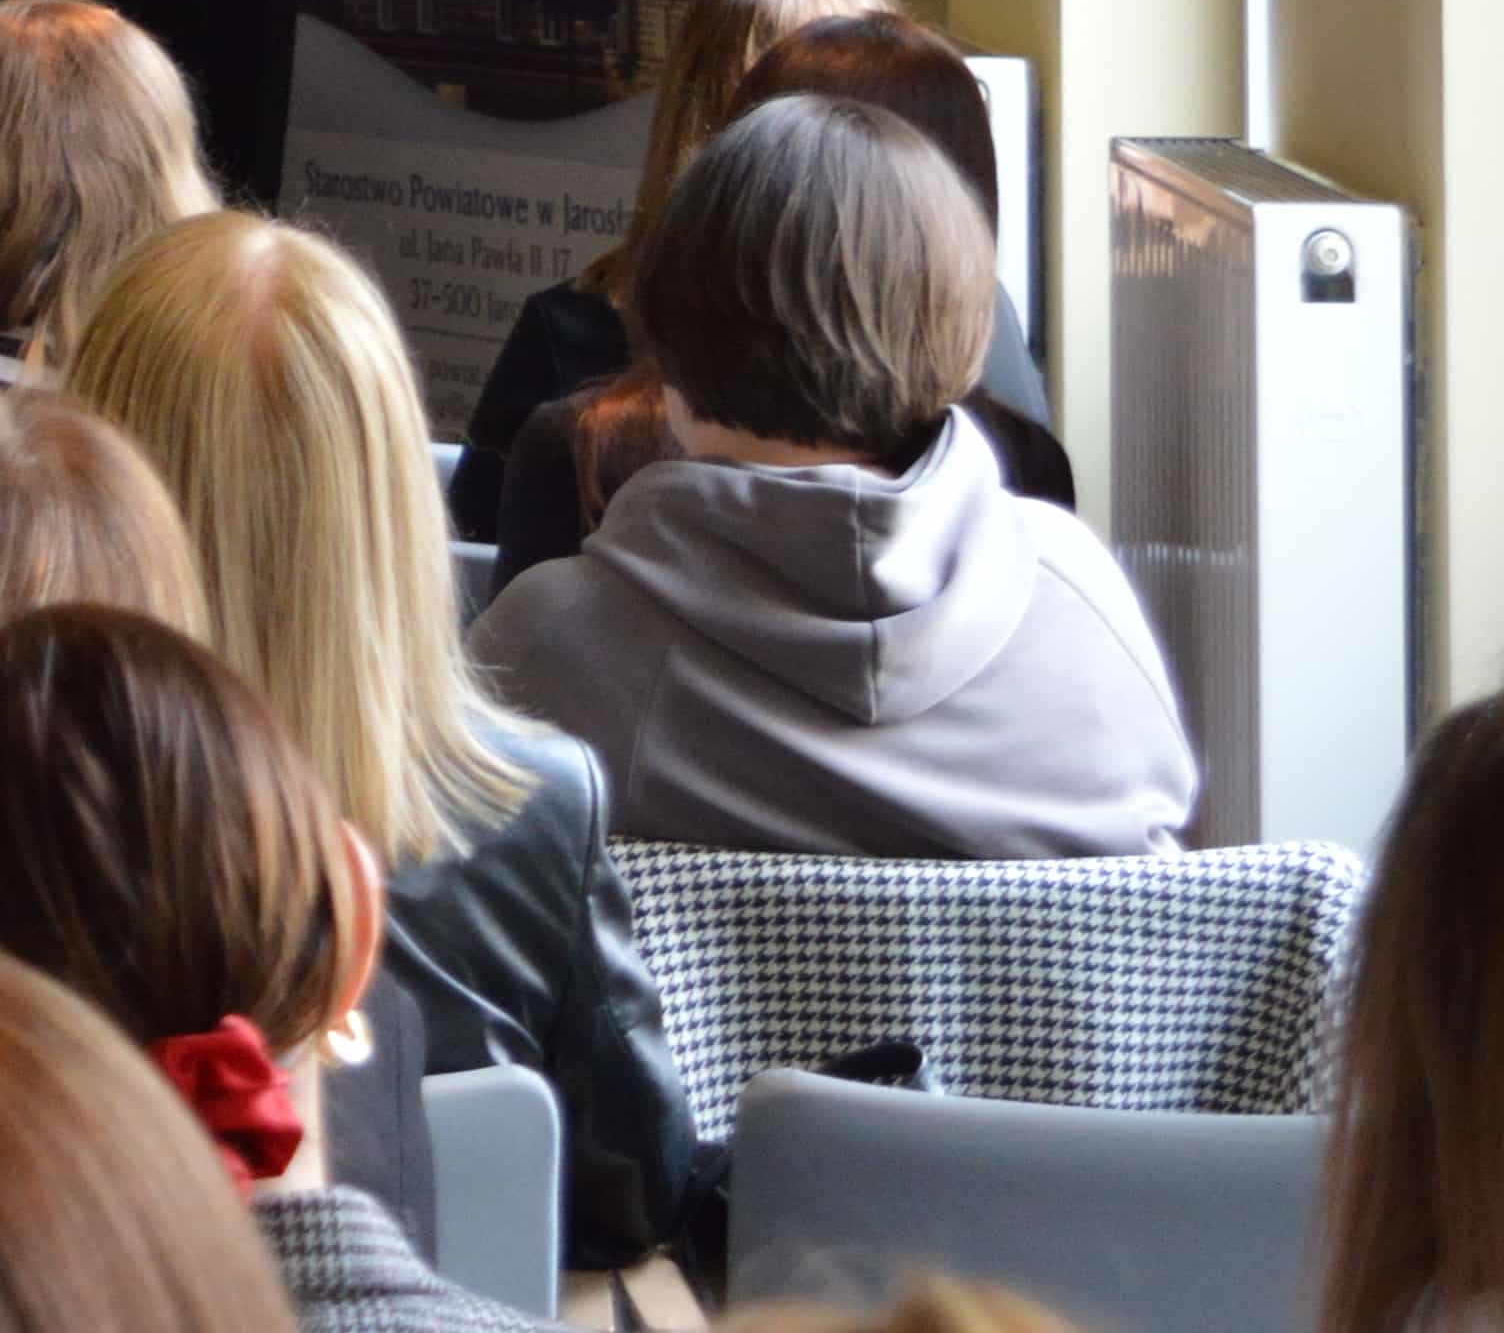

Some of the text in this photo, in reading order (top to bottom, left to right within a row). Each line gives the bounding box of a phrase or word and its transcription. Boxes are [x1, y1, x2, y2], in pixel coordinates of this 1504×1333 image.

[304, 161, 633, 237] Starostwo Powiatowe w Jarosł
[426, 232, 465, 266] Jana
[471, 238, 525, 276] Pawła
[529, 244, 543, 276] II
[409, 277, 482, 318] 37-500
